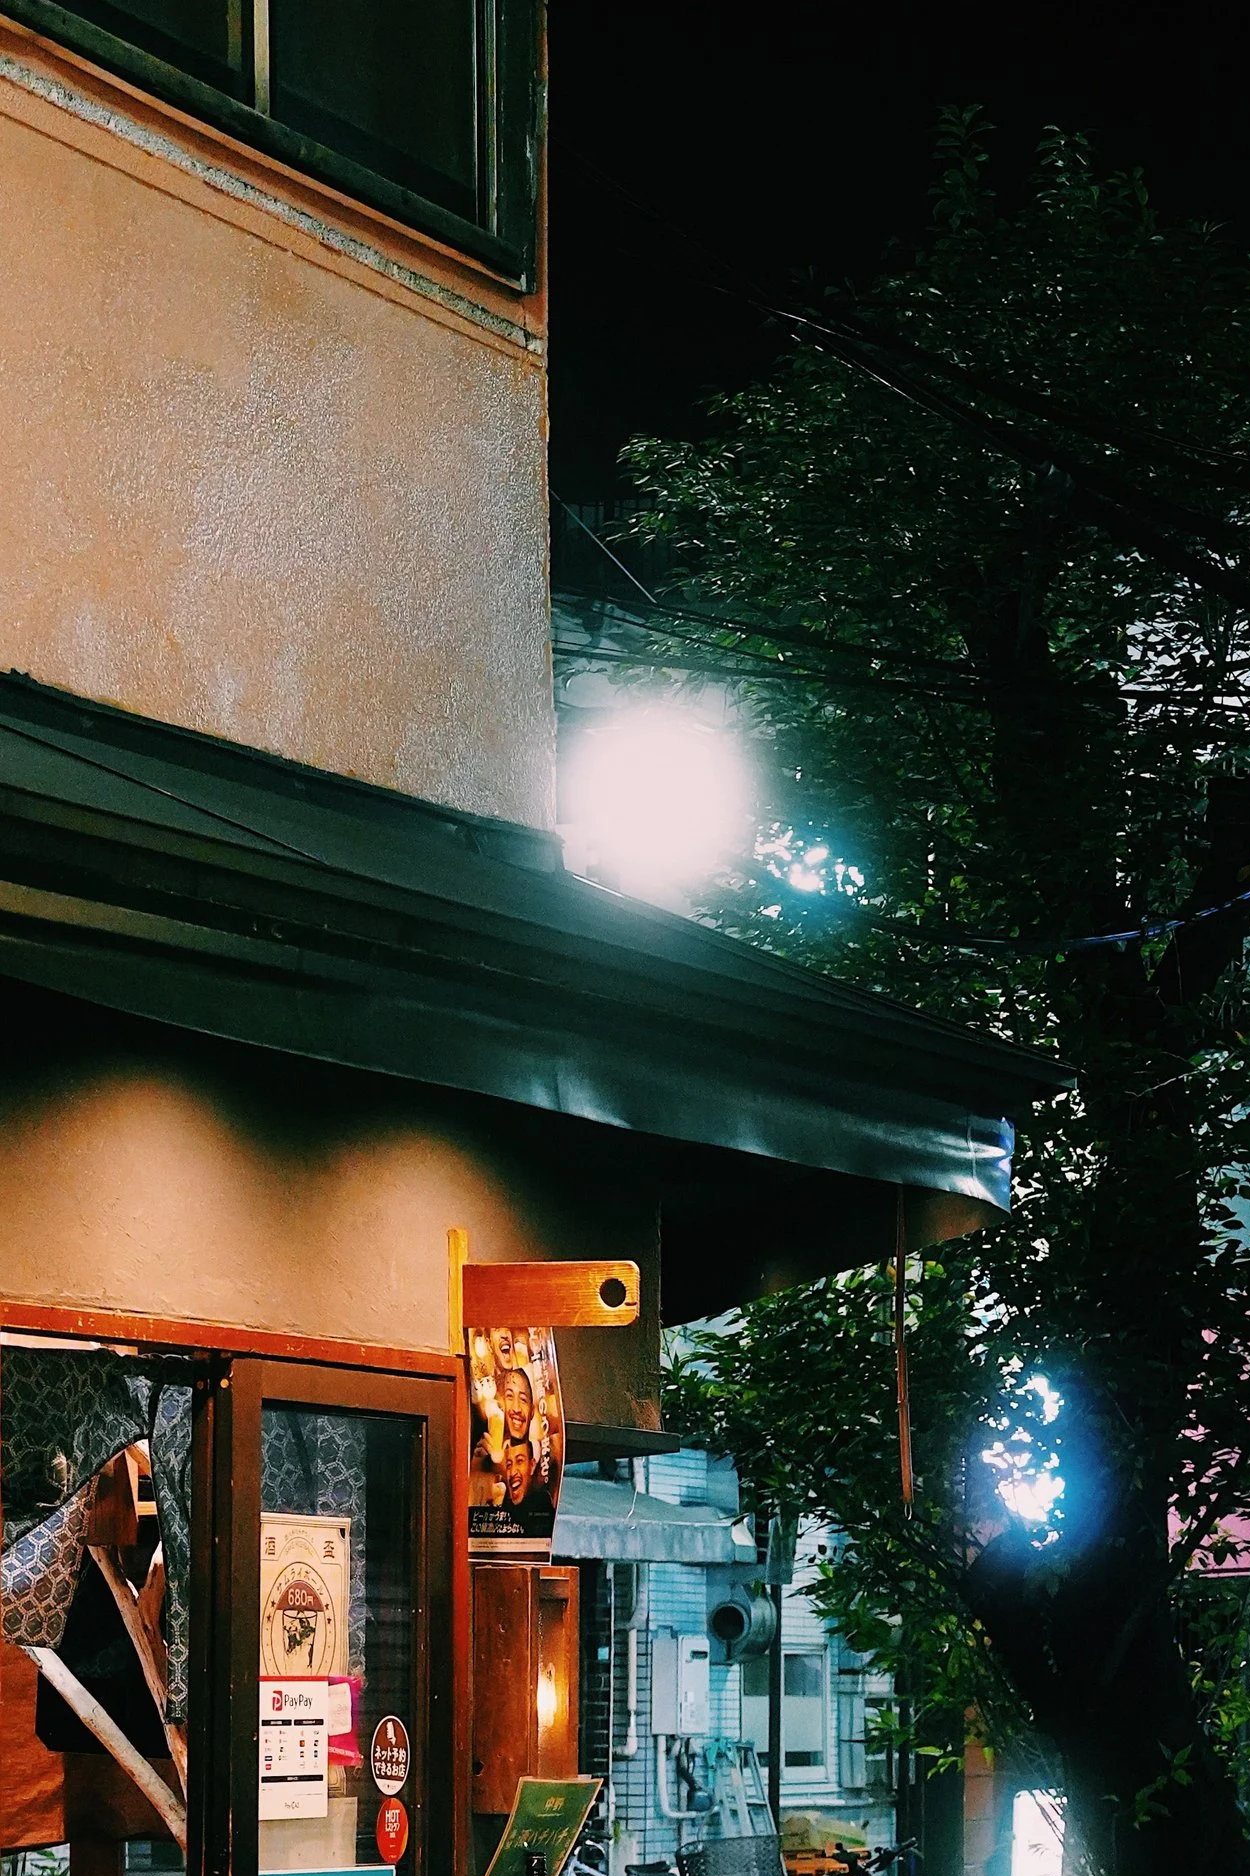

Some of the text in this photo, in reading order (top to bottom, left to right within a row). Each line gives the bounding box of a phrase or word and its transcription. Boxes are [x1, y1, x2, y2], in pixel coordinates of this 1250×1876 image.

[287, 1588, 314, 1606] 680円
[284, 1693, 313, 1709] PayPay
[374, 1745, 407, 1762] ネット予約
[374, 1761, 406, 1777] できるお店
[385, 1809, 400, 1822] HOT
